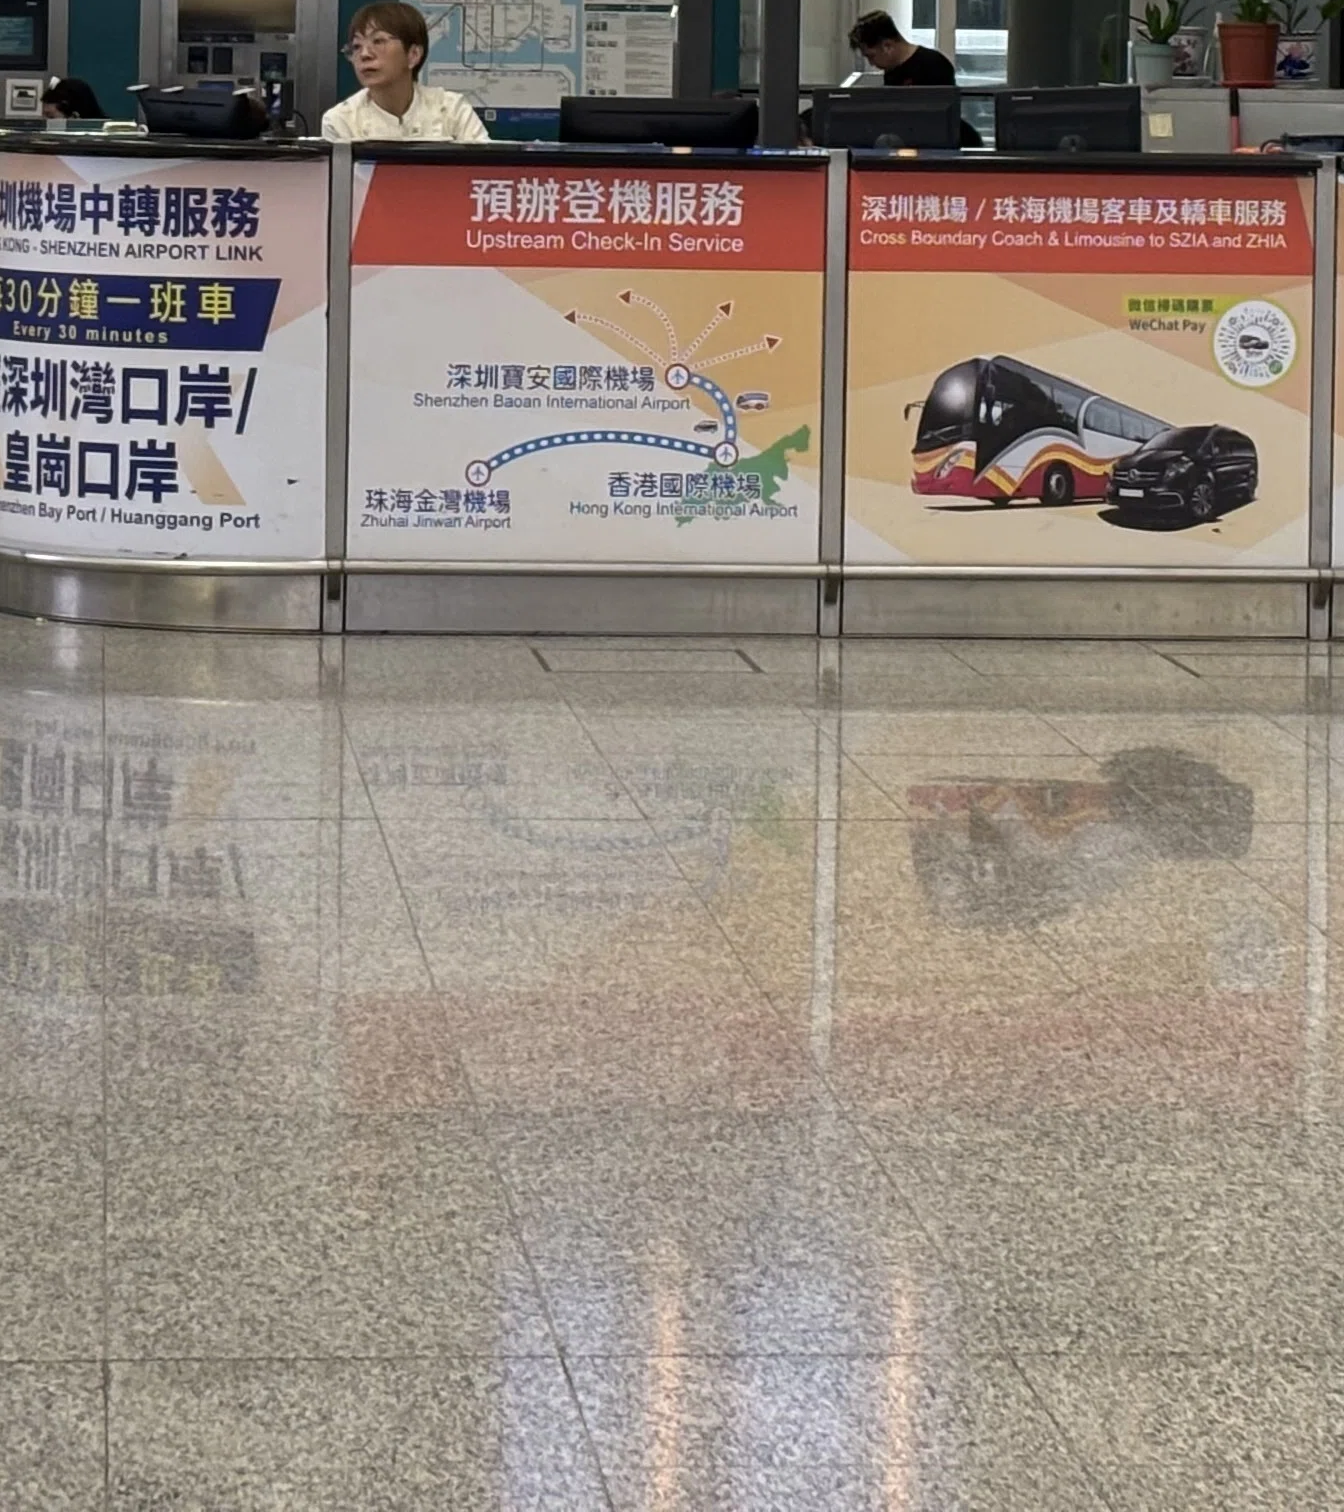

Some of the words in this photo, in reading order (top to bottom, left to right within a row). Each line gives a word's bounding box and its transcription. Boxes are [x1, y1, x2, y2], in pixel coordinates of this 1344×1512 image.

[469, 177, 745, 227] 預辦登機服務
[861, 195, 968, 224] 深圳機場
[993, 196, 1287, 227] 珠海機場客車及轎車服務
[3, 237, 30, 254] KONG
[40, 240, 120, 258] SHENZHEN
[124, 242, 209, 261] AIRPORT
[215, 244, 263, 262] LINK
[466, 229, 564, 252] Upstream
[572, 230, 662, 252] Check-In
[668, 232, 744, 253] Service
[860, 229, 906, 245] Cross
[911, 229, 987, 249] Boundary
[992, 231, 1043, 247] Coach
[1048, 231, 1060, 247] &
[1064, 231, 1145, 248] Limousine
[1149, 233, 1164, 248] to
[1169, 233, 1209, 248] SZIA
[1213, 233, 1241, 248] and
[1246, 233, 1287, 249] ZHIA
[13, 320, 50, 341] Every
[58, 322, 77, 340] 30
[86, 325, 169, 345] minutes
[1129, 318, 1180, 332] WeChat
[1183, 318, 1206, 334] Pay
[446, 363, 655, 393] 深圳寶安國際機場
[413, 392, 489, 409] Shenzhen
[493, 394, 542, 410] Baoan
[545, 394, 639, 410] International
[641, 395, 690, 415] Airport
[4, 429, 180, 506] 皇崗口岸
[608, 471, 761, 500] 香港國際機場
[365, 489, 511, 514] 珠海金灣機場
[569, 500, 608, 519] Hong
[613, 500, 653, 519] Kong
[656, 500, 746, 518] International
[748, 501, 799, 520] Airport
[38, 502, 63, 523] Bay
[67, 505, 97, 522] Port
[111, 510, 213, 531] Huanggang
[220, 511, 261, 529] Port
[360, 513, 409, 529] Zhuhai
[412, 513, 462, 529] Jinwan
[464, 514, 511, 532] Airport
